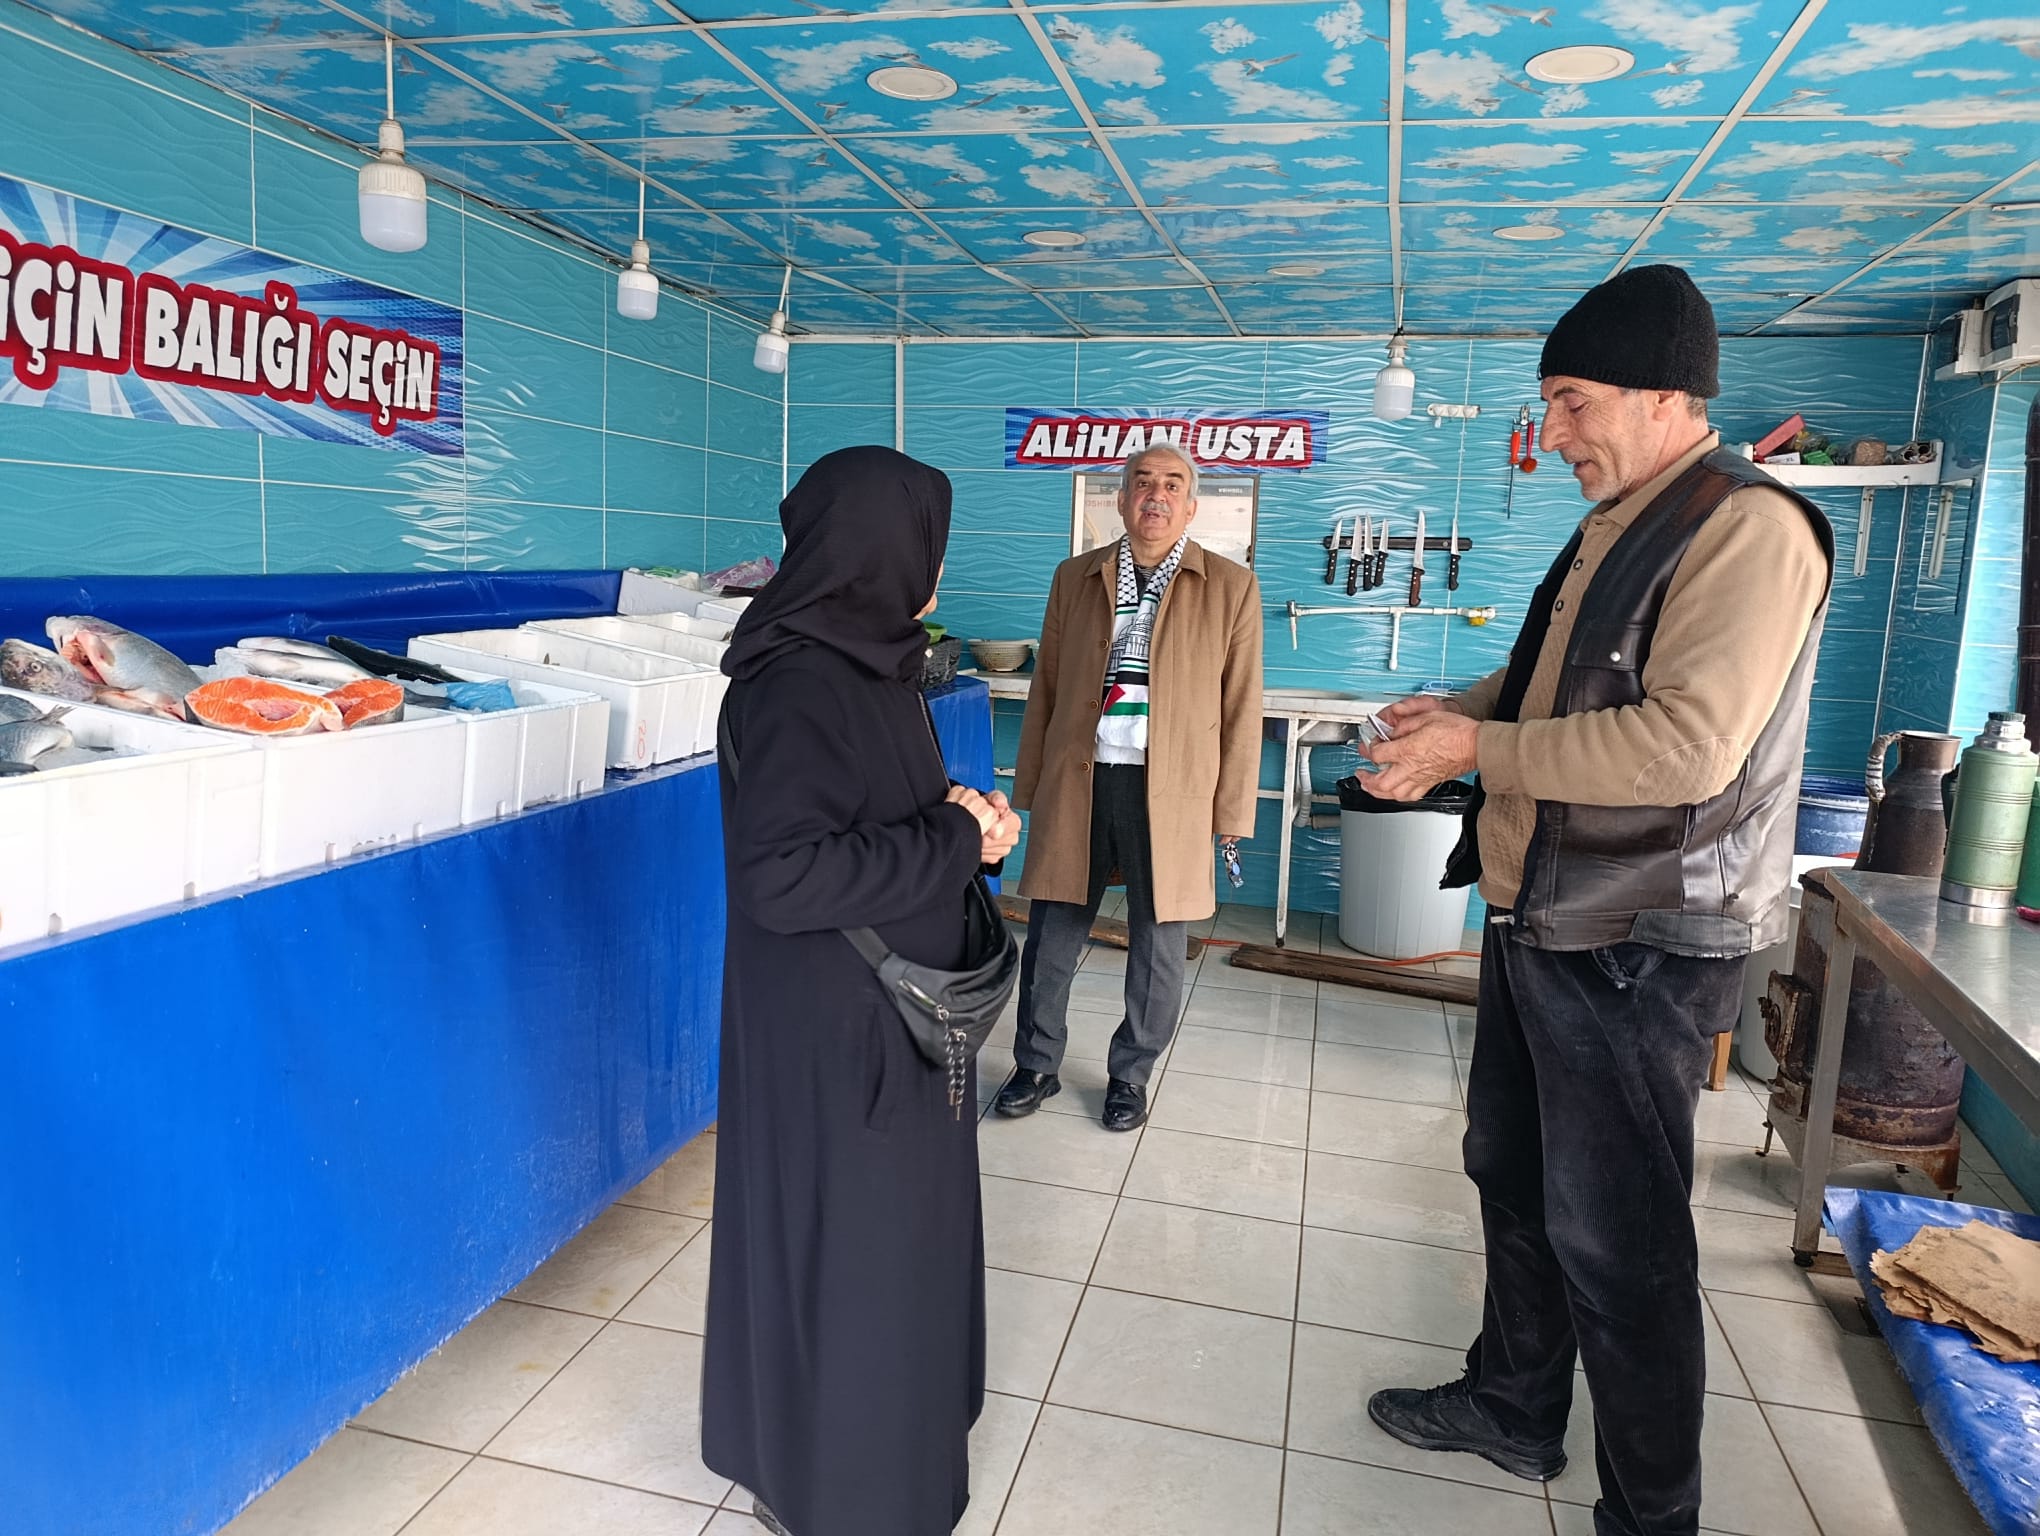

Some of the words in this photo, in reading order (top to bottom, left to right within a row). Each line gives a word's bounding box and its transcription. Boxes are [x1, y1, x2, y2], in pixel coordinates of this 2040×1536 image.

[144, 286, 313, 392] BALIĞI
[323, 329, 435, 426] SEÇİN
[1023, 422, 1184, 458] ALİHAN
[1197, 425, 1306, 461] USTA
